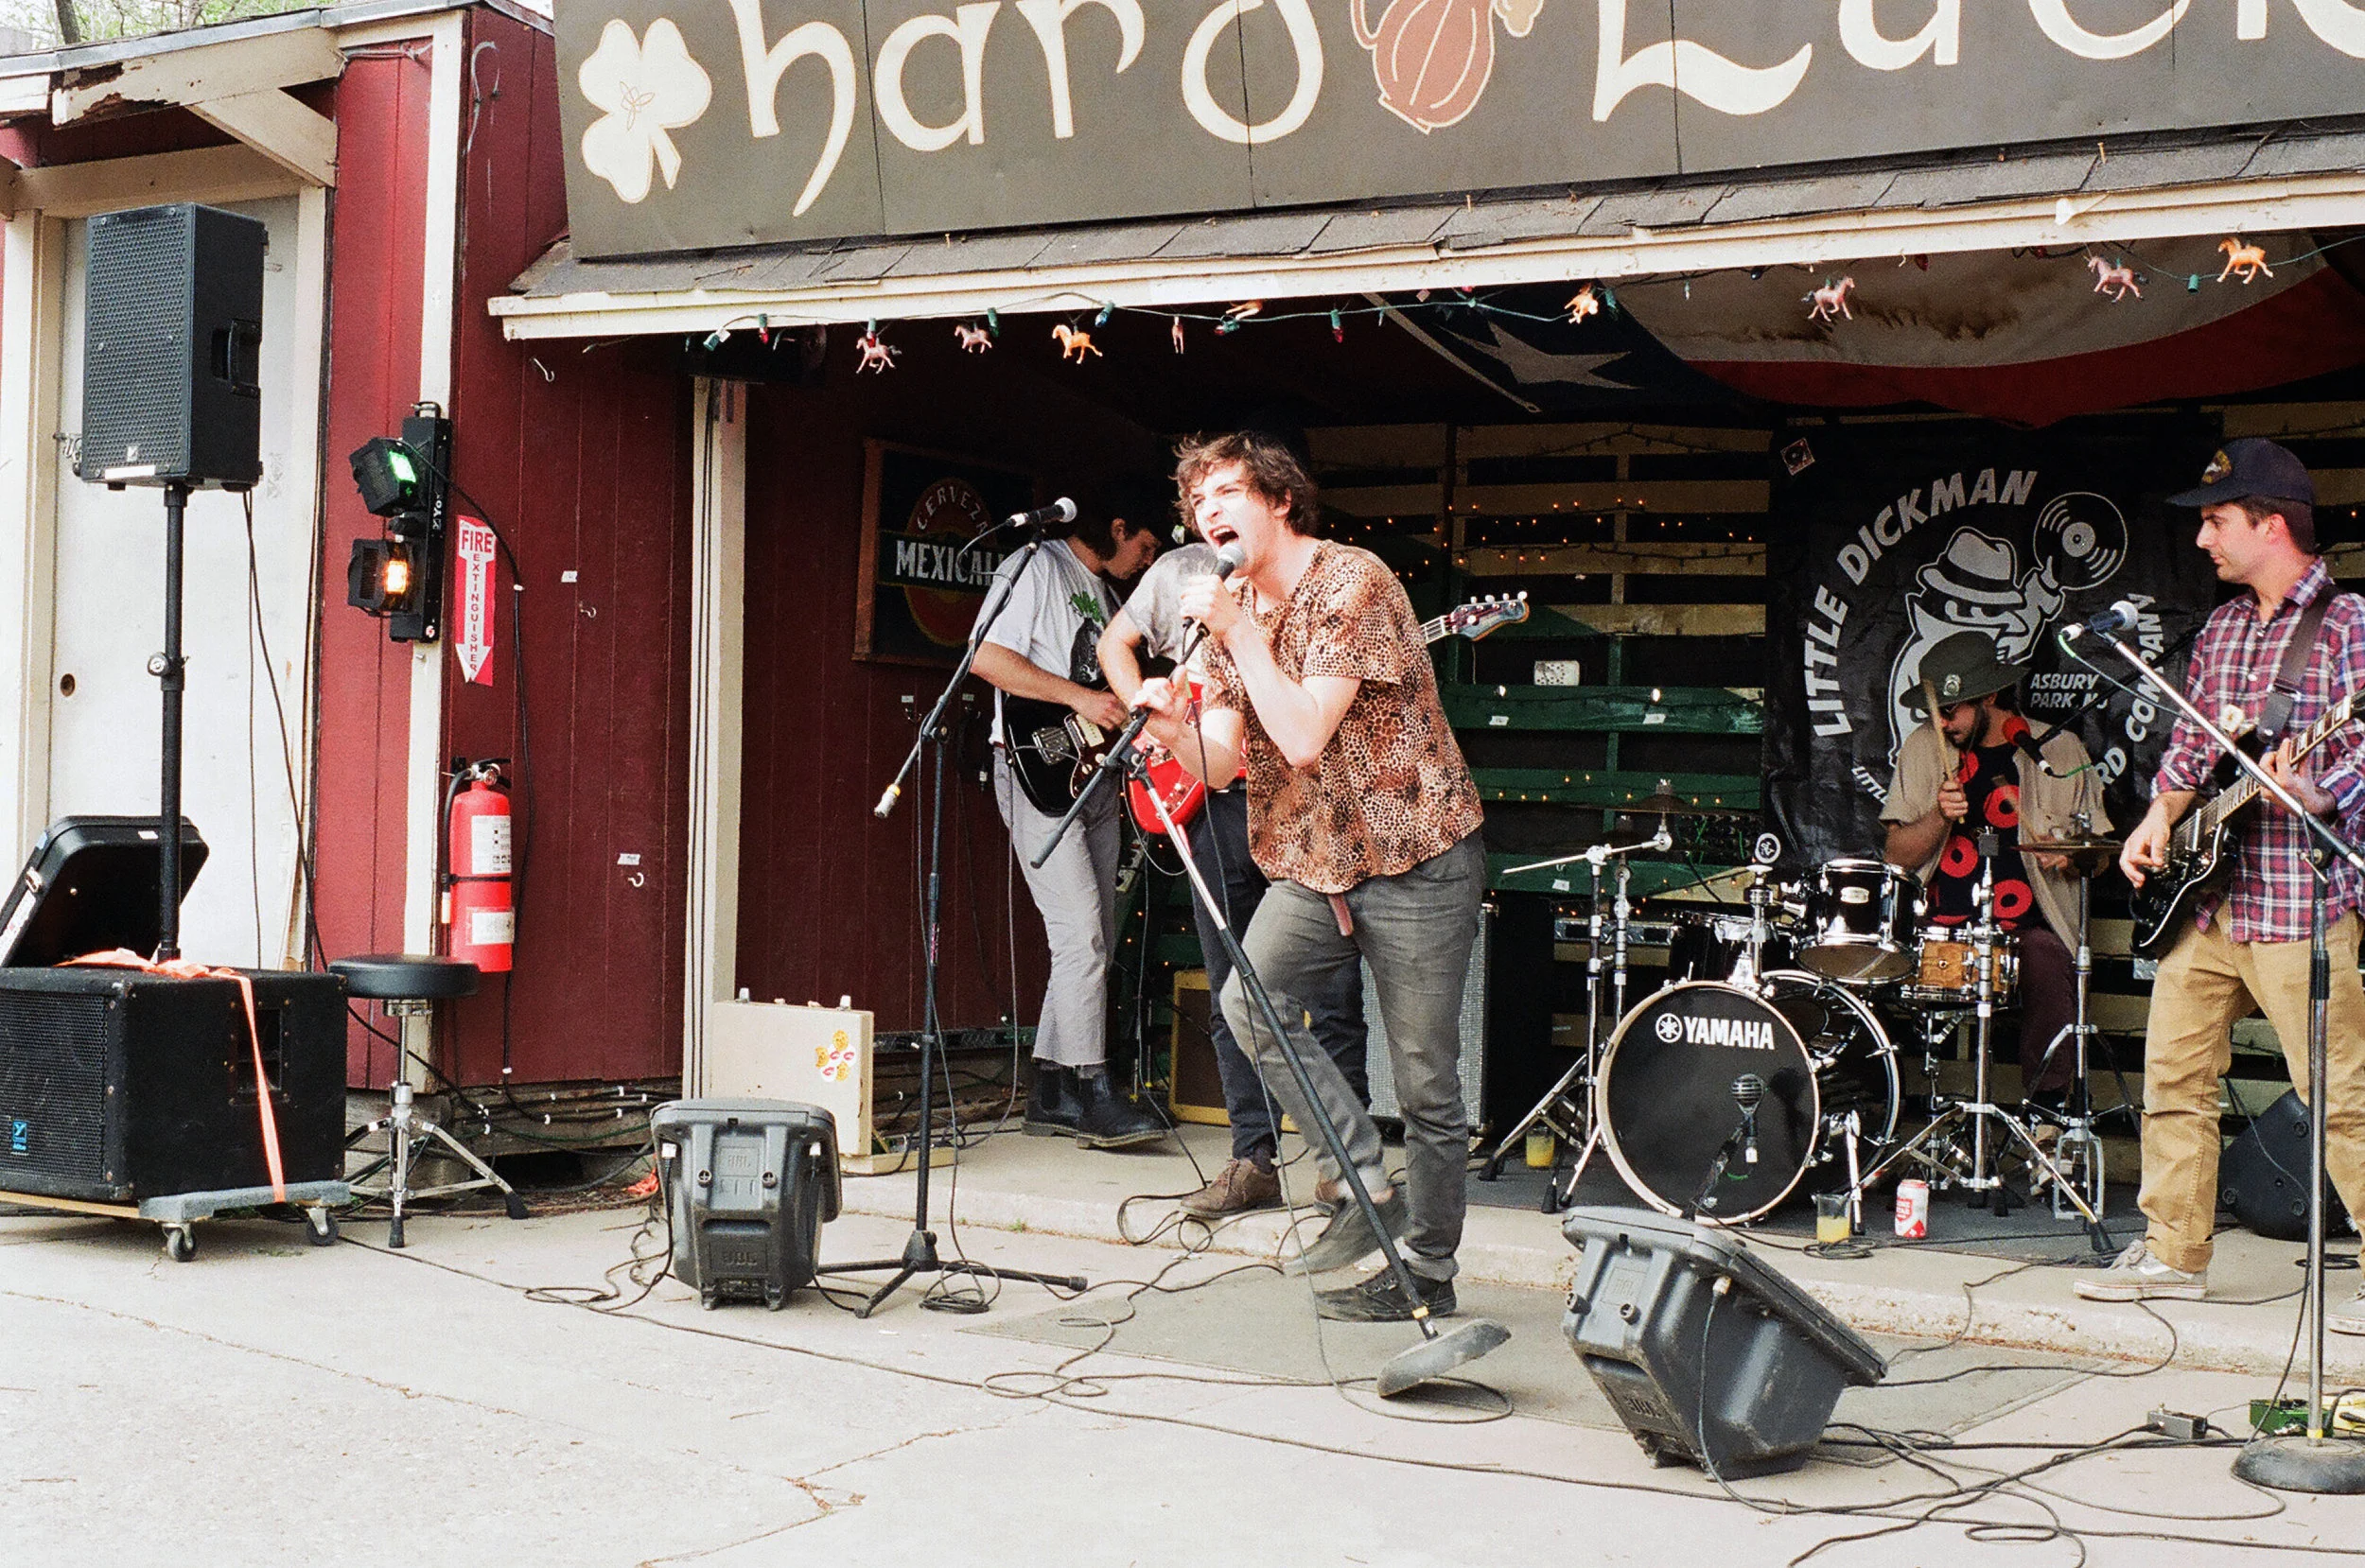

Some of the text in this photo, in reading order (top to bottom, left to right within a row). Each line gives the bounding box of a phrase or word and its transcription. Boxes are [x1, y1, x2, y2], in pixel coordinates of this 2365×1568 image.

[462, 530, 494, 552] FIRE
[896, 540, 1006, 586] MEXICAL
[469, 553, 481, 671] EXTINGUISHER
[1804, 468, 2038, 737] LITTLE DICKMAN
[2030, 672, 2100, 690] ASBURY
[1684, 1016, 1775, 1050] YAMAHA
